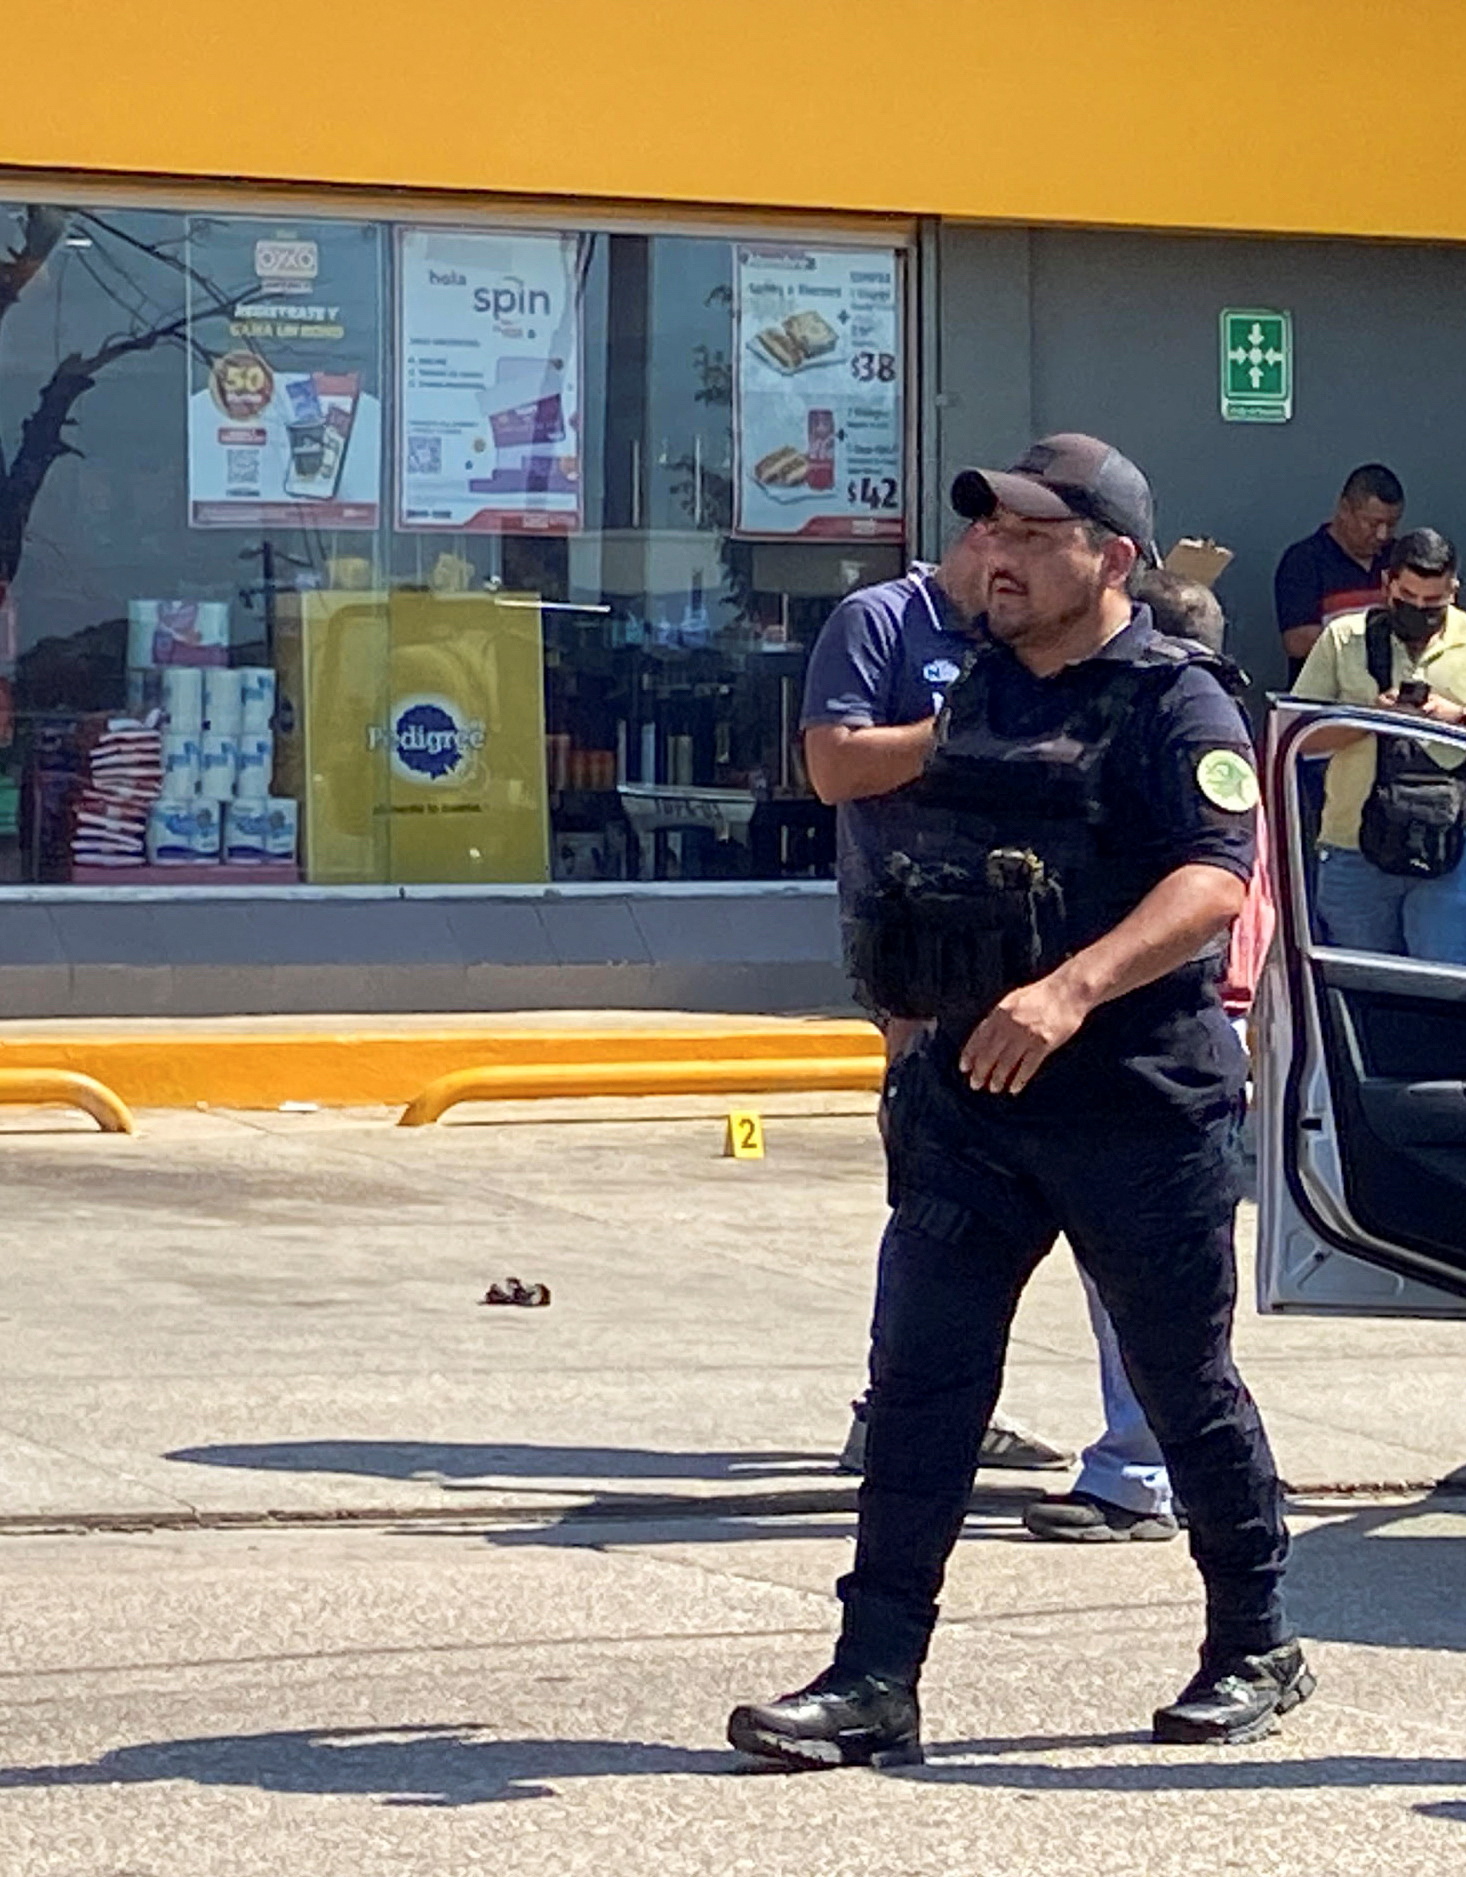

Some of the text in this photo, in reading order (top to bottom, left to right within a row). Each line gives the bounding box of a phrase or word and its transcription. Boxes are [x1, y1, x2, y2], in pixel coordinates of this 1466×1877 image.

[474, 277, 550, 320] spin
[224, 366, 265, 393] 50
[851, 352, 897, 383] $38
[847, 477, 898, 510] $42
[739, 1118, 757, 1148] 2
